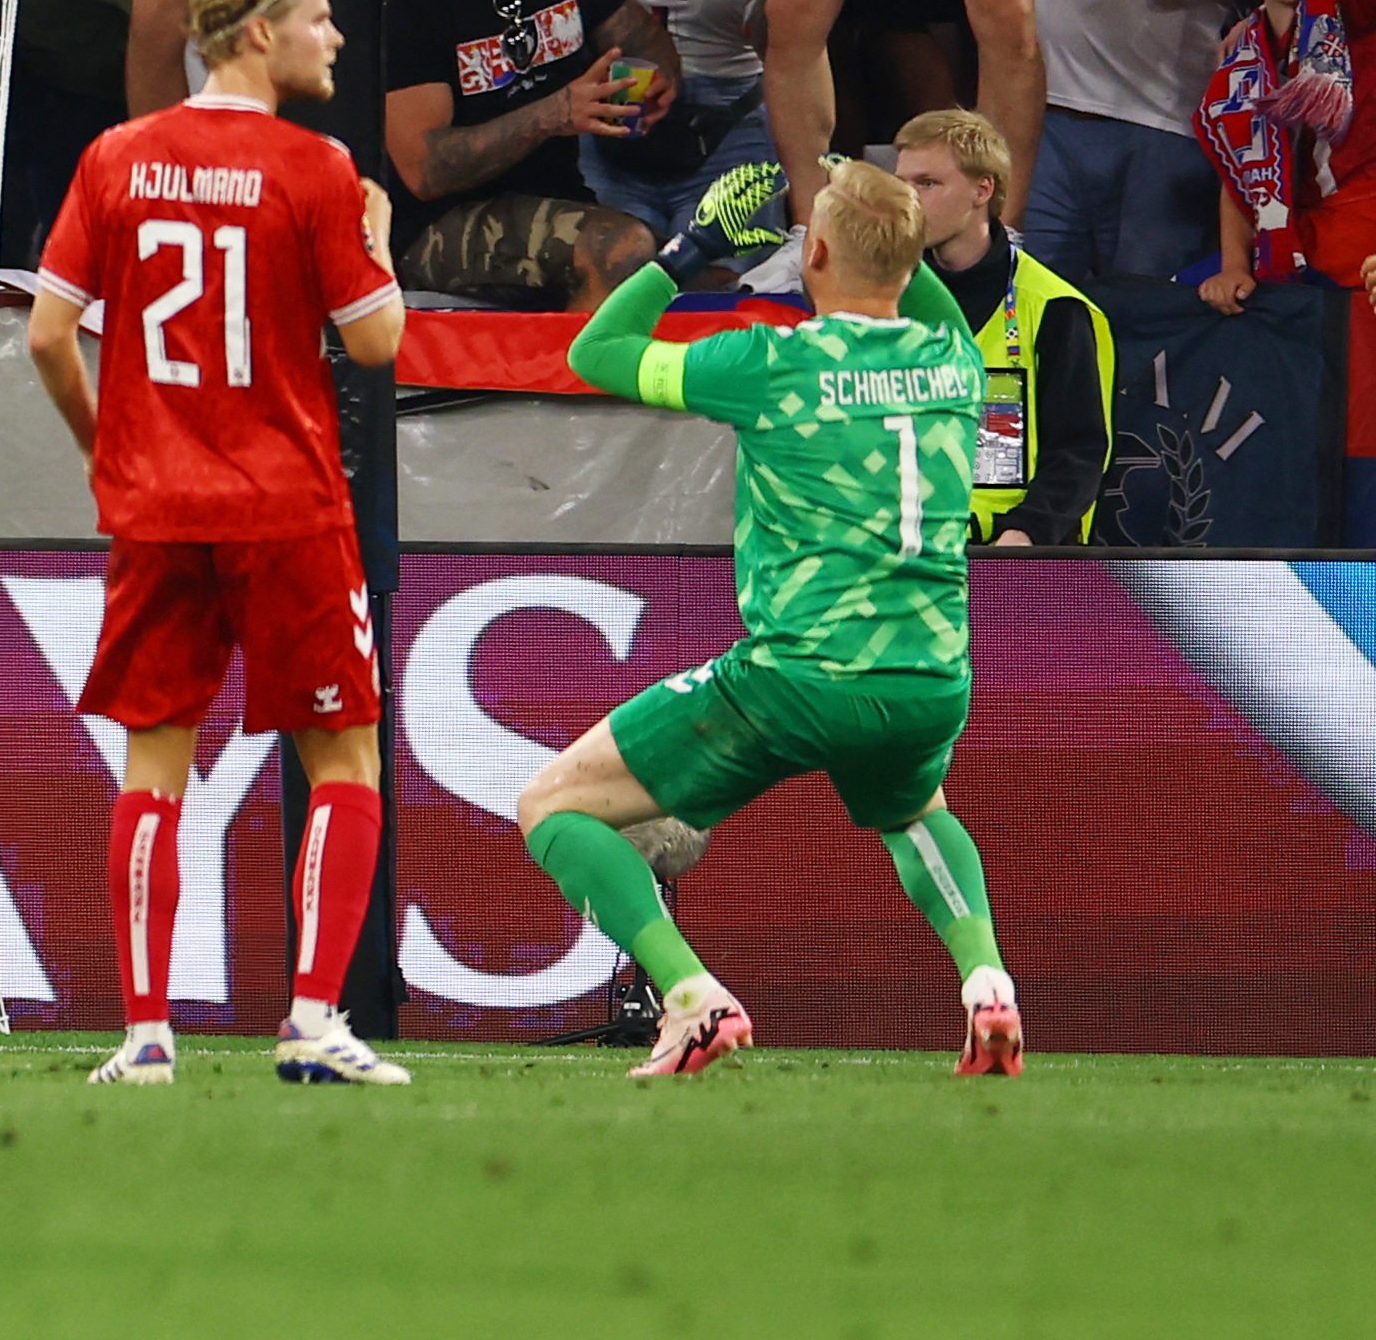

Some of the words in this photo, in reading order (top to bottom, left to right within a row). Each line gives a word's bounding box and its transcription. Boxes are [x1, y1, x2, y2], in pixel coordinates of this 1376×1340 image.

[129, 162, 263, 206] HJULMAND
[138, 219, 252, 388] 21
[818, 364, 969, 407] SCHMEICHEL
[883, 415, 923, 557] 1
